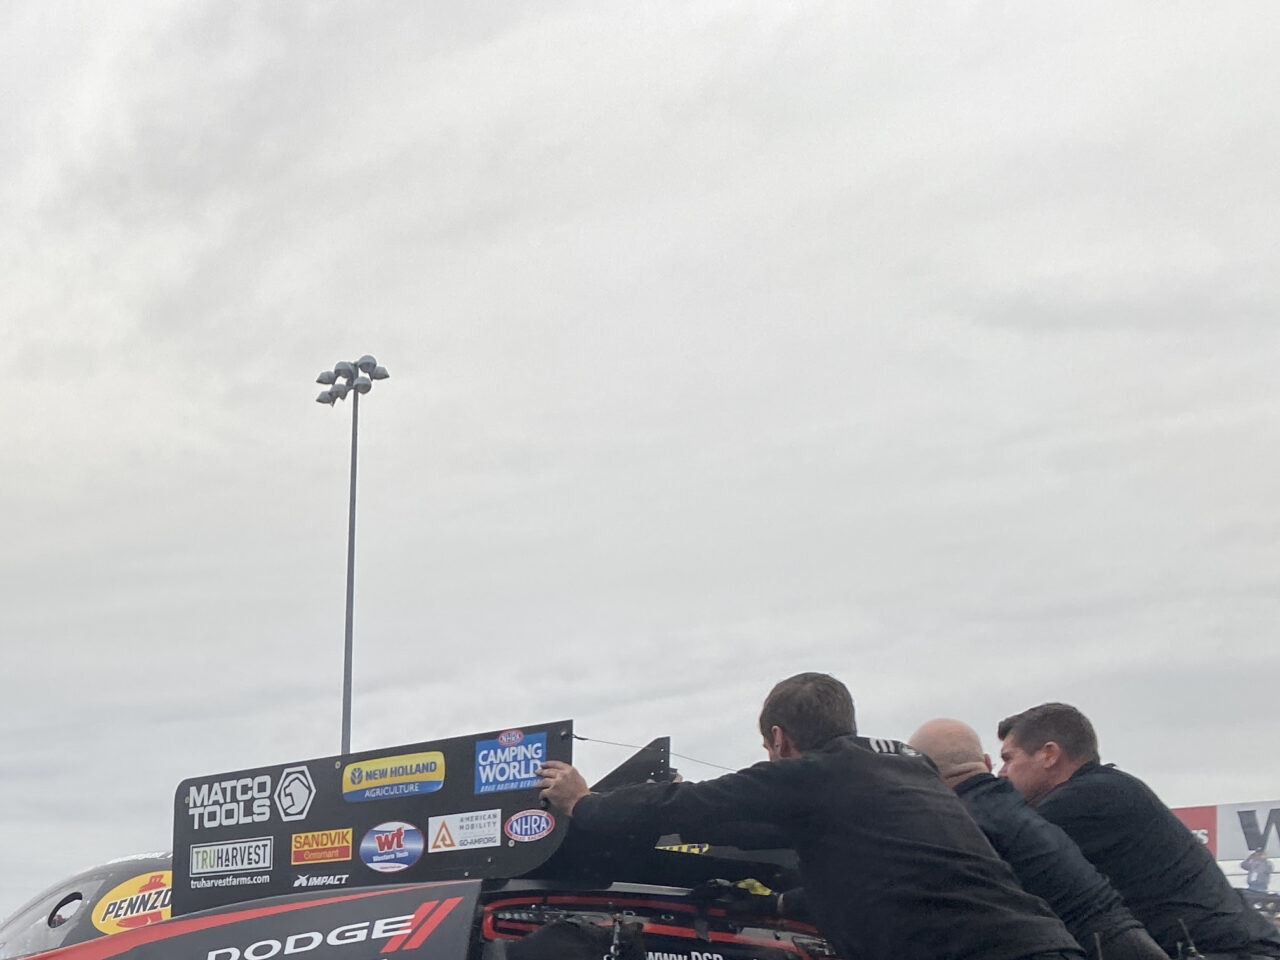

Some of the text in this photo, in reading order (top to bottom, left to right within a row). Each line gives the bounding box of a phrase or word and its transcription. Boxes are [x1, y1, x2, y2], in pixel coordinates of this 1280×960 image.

[478, 743, 542, 766] CAMPING
[365, 761, 437, 781] NEW HOLLAND
[479, 759, 542, 783] WORLD
[189, 775, 271, 807] MATCO
[365, 783, 420, 798] AGRICULTURE
[188, 798, 271, 829] TOOLS
[460, 814, 497, 822] AMERICAN
[459, 821, 497, 831] MOBILITY
[512, 815, 548, 835] NHRA
[293, 831, 350, 849] SANDVIK
[195, 844, 269, 870] TRUHARVEST
[190, 875, 270, 889] truharvestfarms.com
[308, 875, 350, 886] IMPACT
